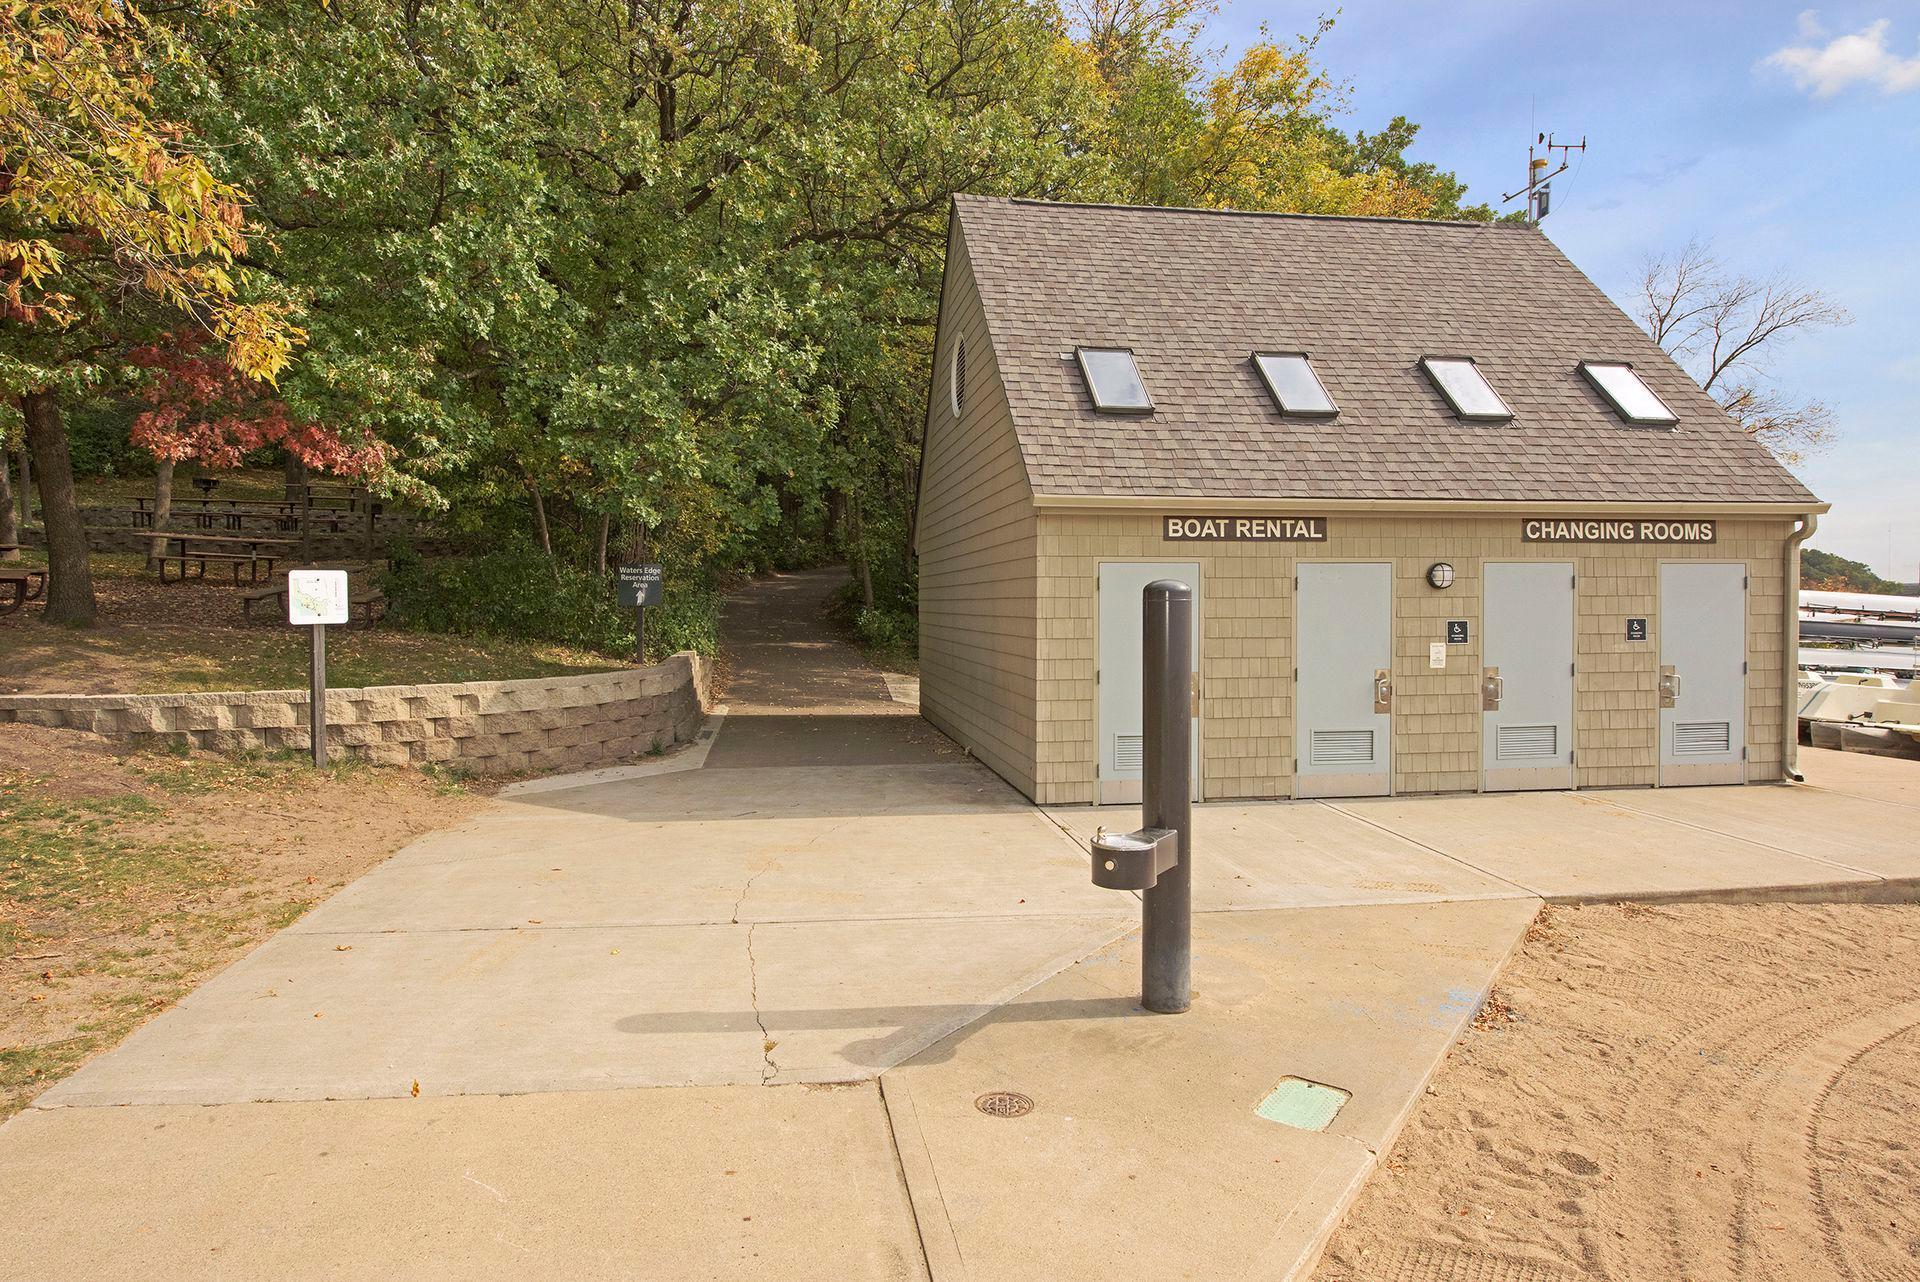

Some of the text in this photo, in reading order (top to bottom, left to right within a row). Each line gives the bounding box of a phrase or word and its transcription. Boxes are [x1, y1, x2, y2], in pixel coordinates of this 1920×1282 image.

[1168, 519, 1322, 538] BOAT RENTAL
[1526, 521, 1713, 541] CHANGING ROOMS
[619, 566, 661, 575] Waters Edge
